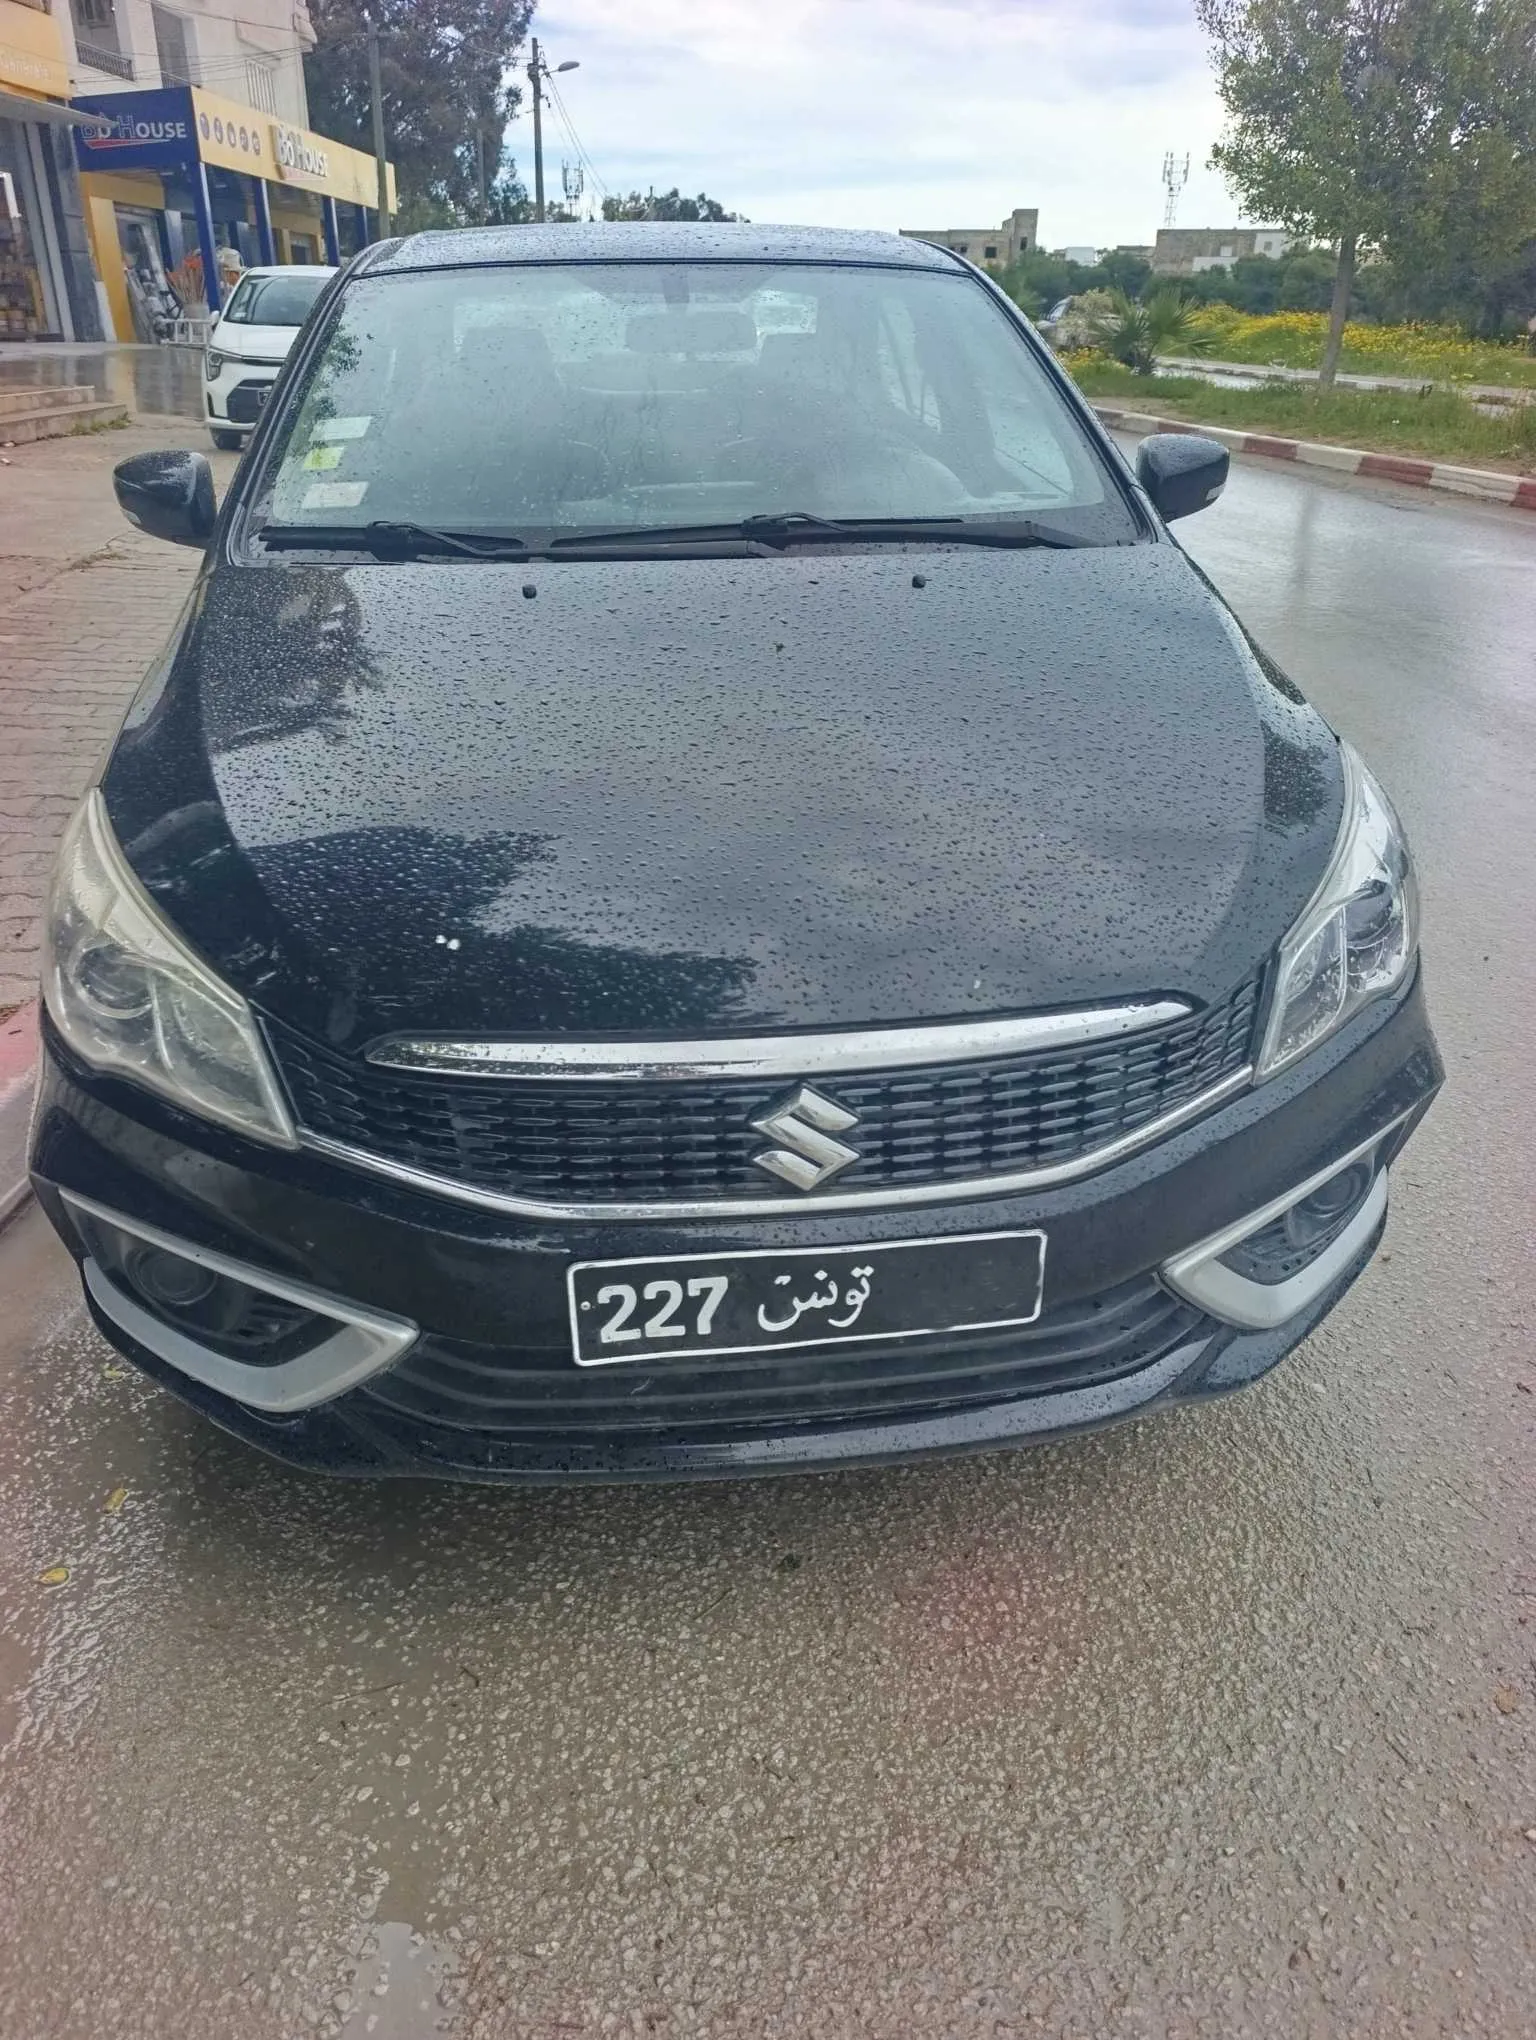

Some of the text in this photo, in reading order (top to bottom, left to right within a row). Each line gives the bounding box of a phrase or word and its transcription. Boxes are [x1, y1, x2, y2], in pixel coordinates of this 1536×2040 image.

[117, 115, 187, 138] HOUSE
[597, 1265, 875, 1343] 227 تونس
